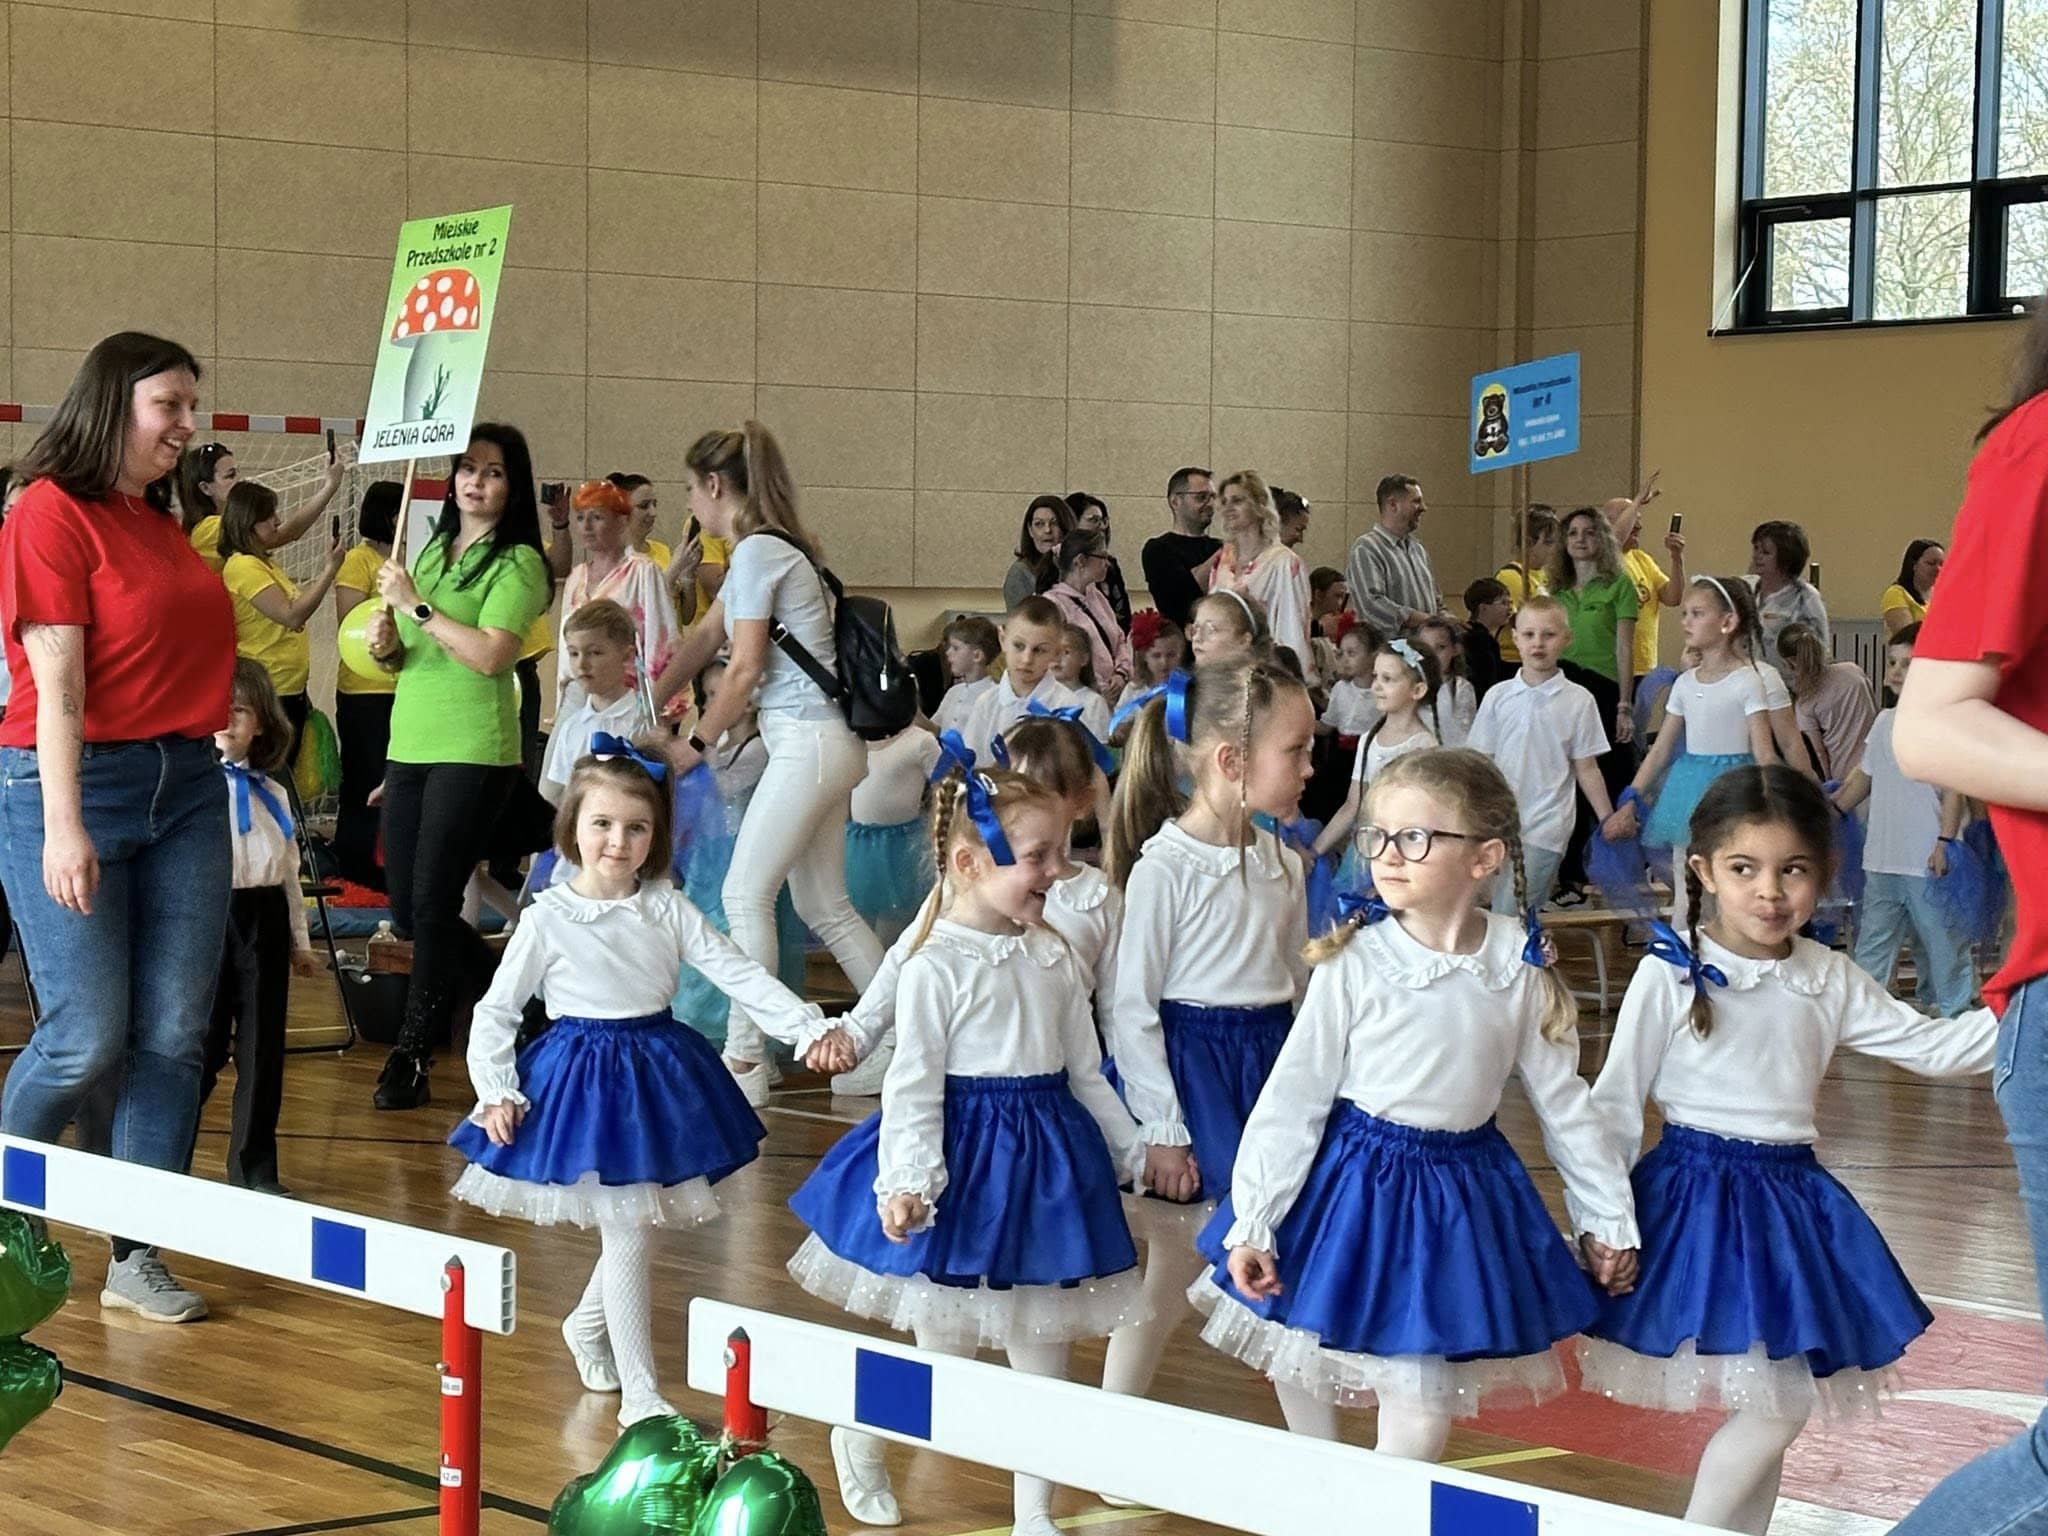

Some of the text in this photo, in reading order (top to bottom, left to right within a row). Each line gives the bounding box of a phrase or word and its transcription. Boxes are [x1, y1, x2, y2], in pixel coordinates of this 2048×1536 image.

[433, 219, 479, 240] Miejskie
[406, 238, 497, 267] Przedszkole nr 2
[372, 420, 455, 448] JELENIA GÓRA
